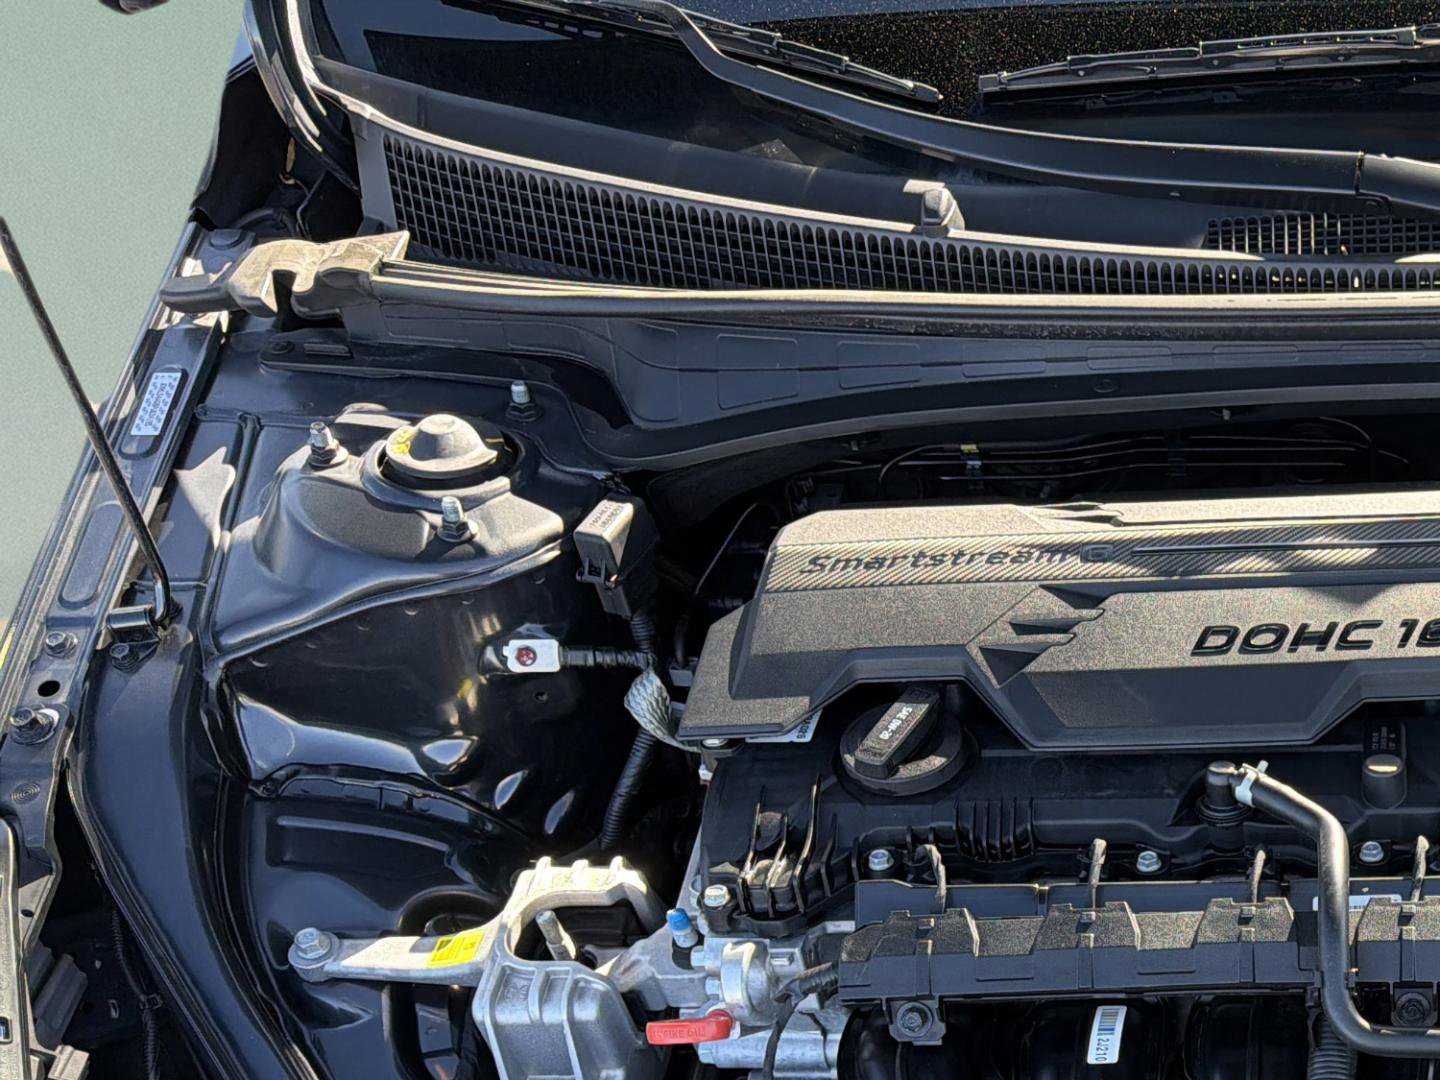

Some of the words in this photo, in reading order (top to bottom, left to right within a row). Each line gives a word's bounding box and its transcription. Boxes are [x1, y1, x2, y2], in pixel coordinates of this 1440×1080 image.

[799, 547, 1070, 574] Smartstream
[1190, 619, 1384, 657] DOHC
[896, 706, 913, 720] SAE
